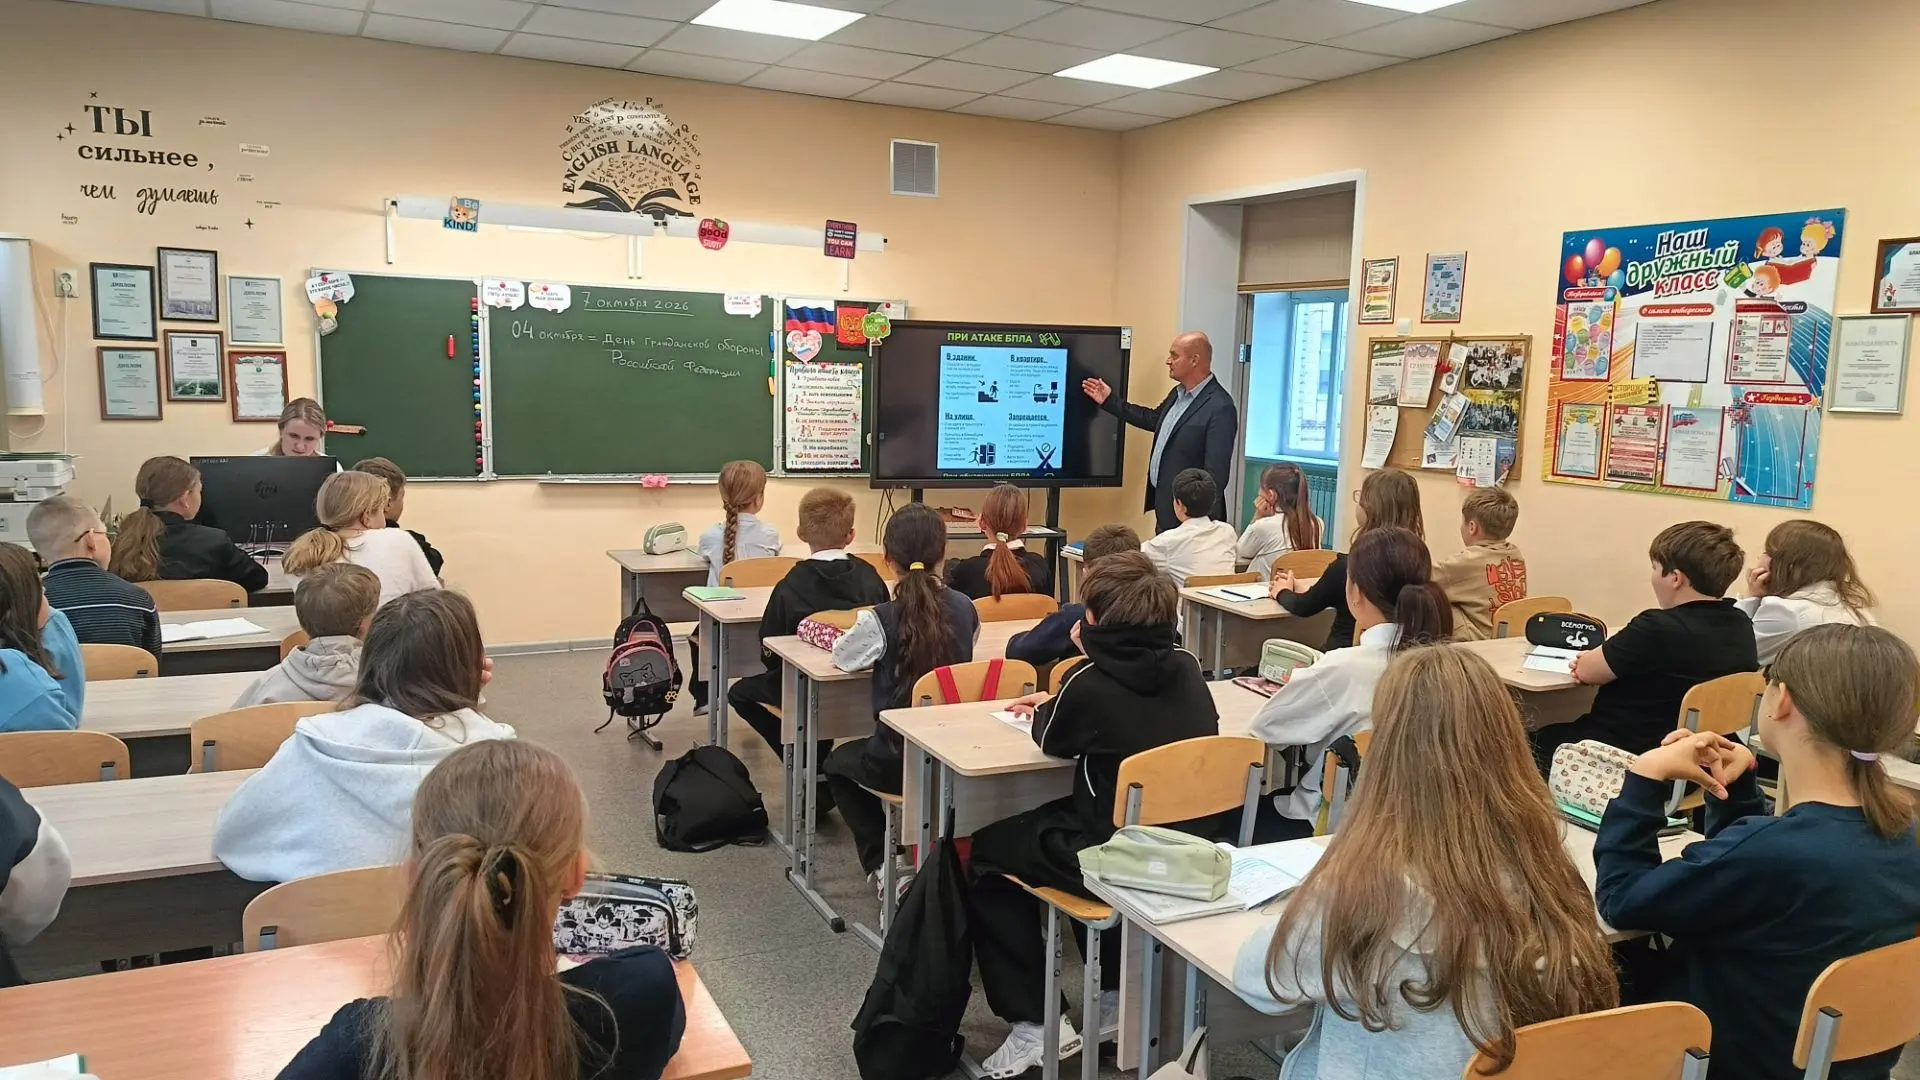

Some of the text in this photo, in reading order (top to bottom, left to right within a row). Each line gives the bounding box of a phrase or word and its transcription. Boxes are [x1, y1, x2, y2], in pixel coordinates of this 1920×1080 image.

[572, 115, 590, 124] YES
[77, 144, 199, 168] сильнее
[561, 140, 701, 205] ENGLISH LANGUAGE
[80, 184, 219, 216] чем думаешь
[1655, 228, 1708, 257] Наш
[1626, 241, 1739, 289] дружный
[1653, 269, 1719, 299] класс
[581, 291, 591, 307] 7
[654, 300, 689, 311] 2026
[947, 332, 1033, 343] ПРИ АТАКЕ БПЛА
